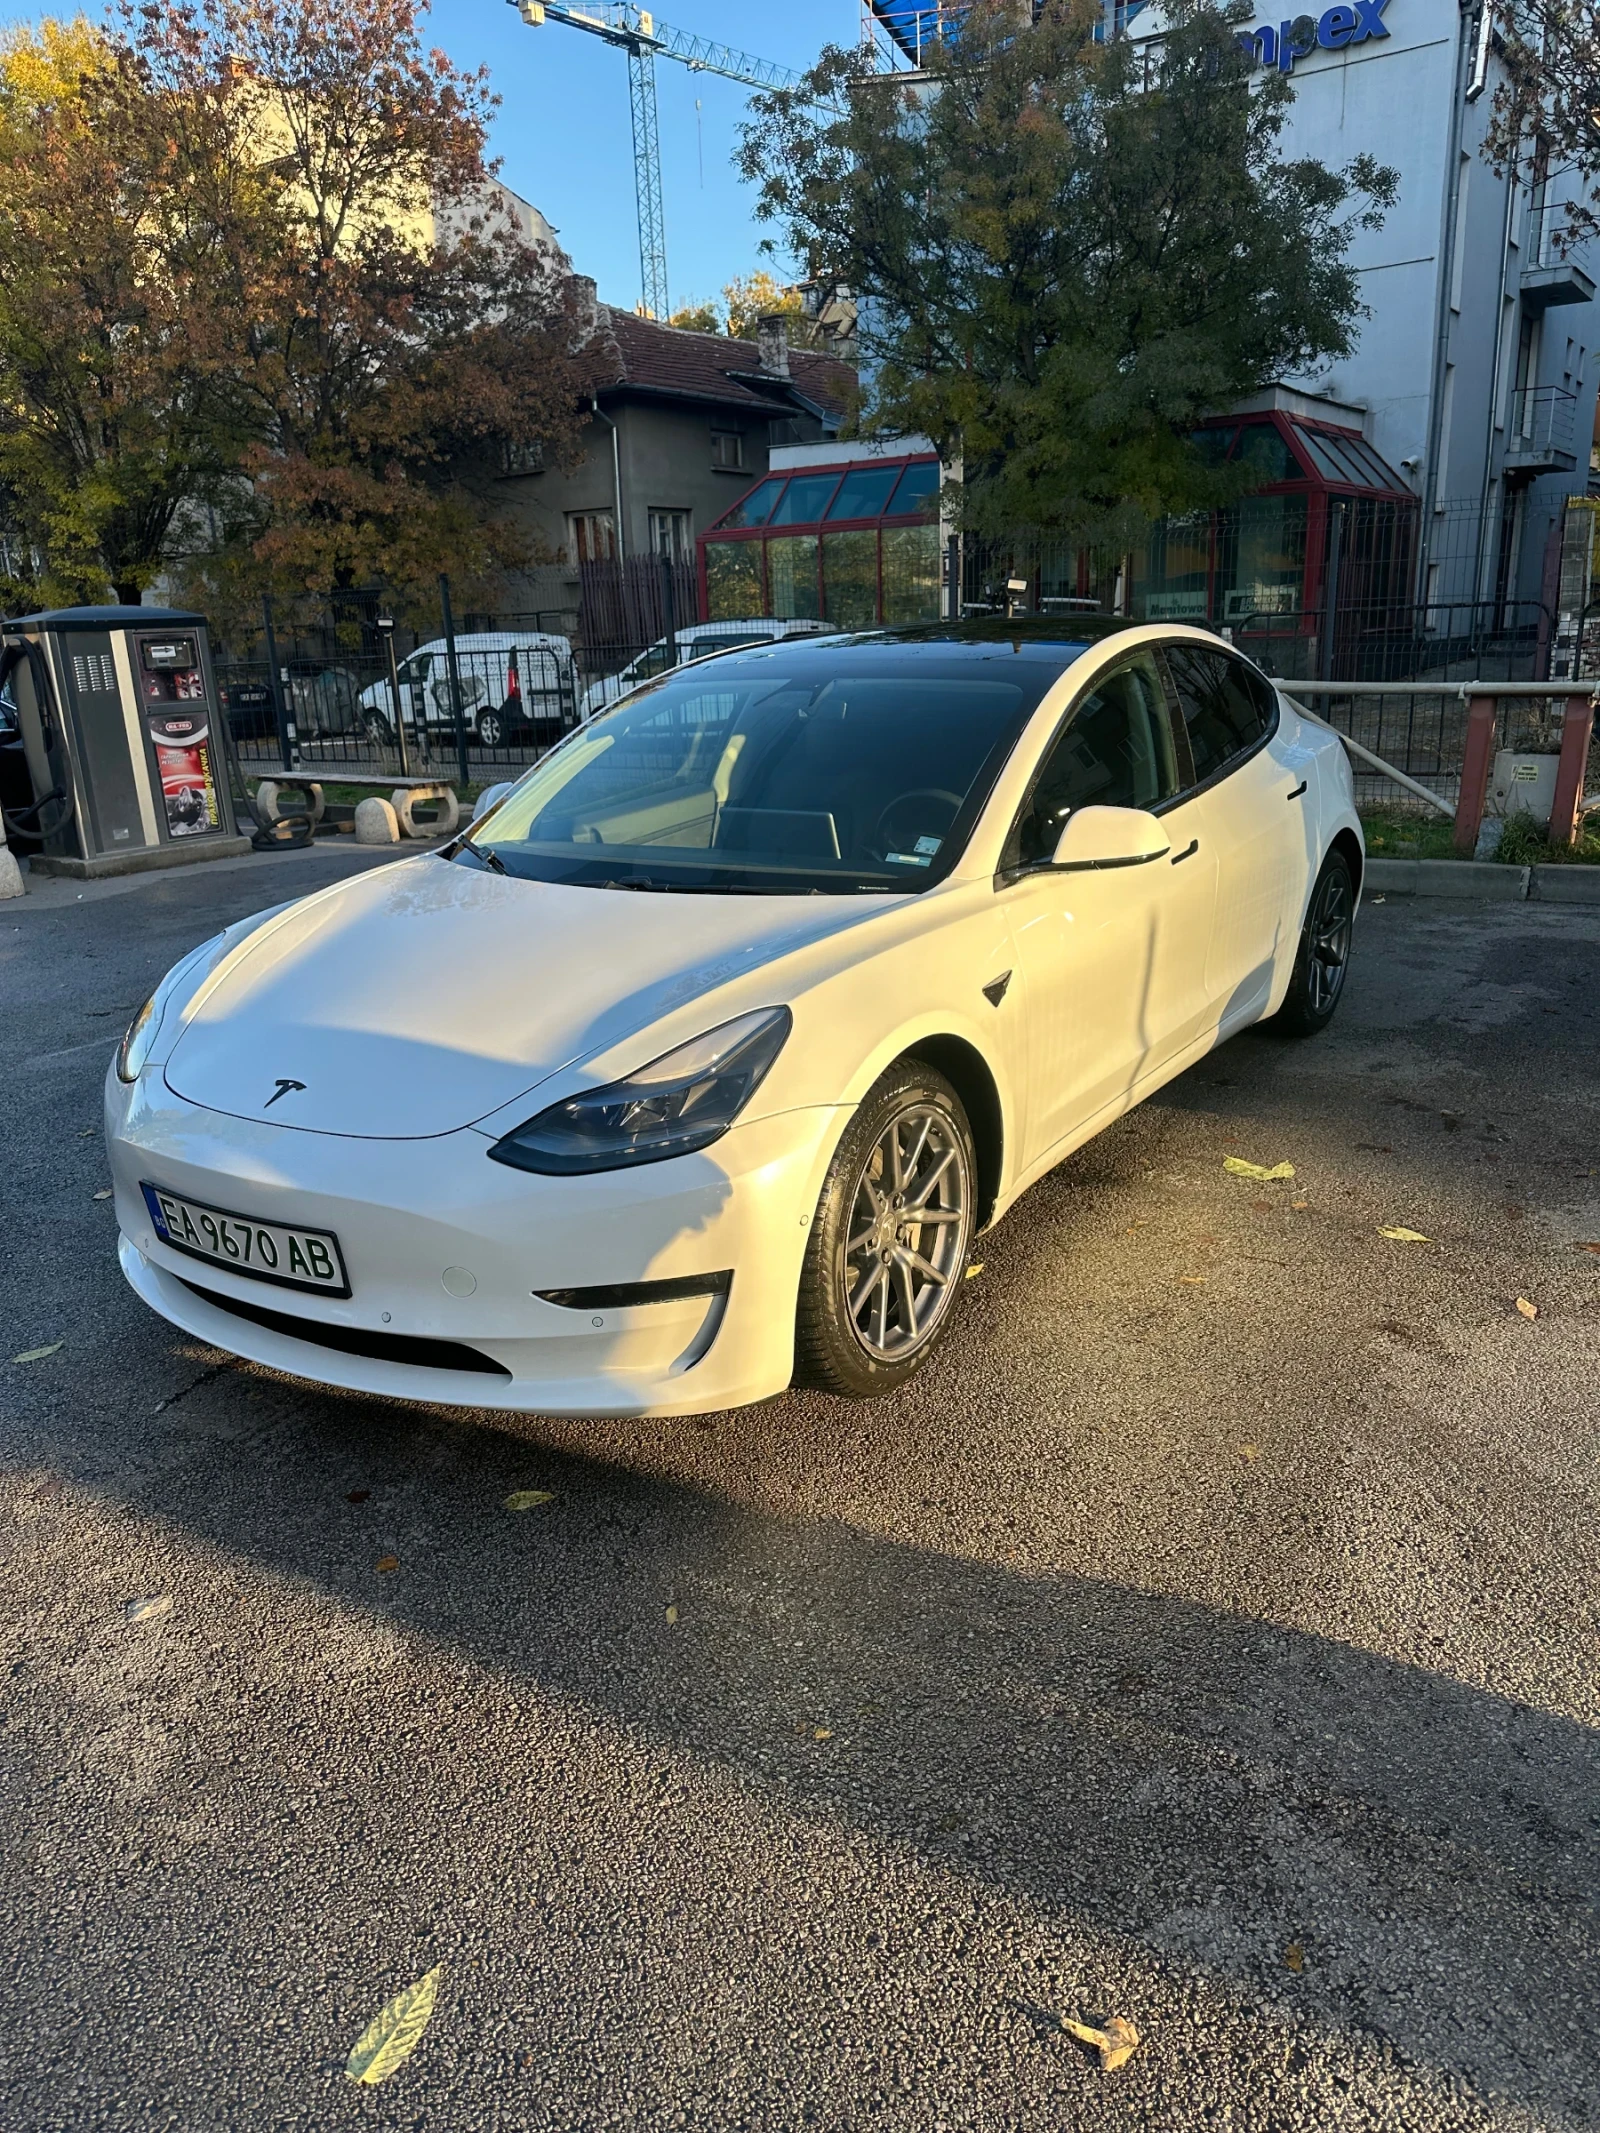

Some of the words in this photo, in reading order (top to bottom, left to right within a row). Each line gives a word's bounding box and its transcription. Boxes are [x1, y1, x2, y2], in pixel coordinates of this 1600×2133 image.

[199, 748, 219, 825] ПРАХОСМУКАЧКА
[155, 1216, 166, 1229] BG
[159, 1196, 202, 1246] EA
[200, 1213, 279, 1269] 9670
[288, 1234, 336, 1280] AB
